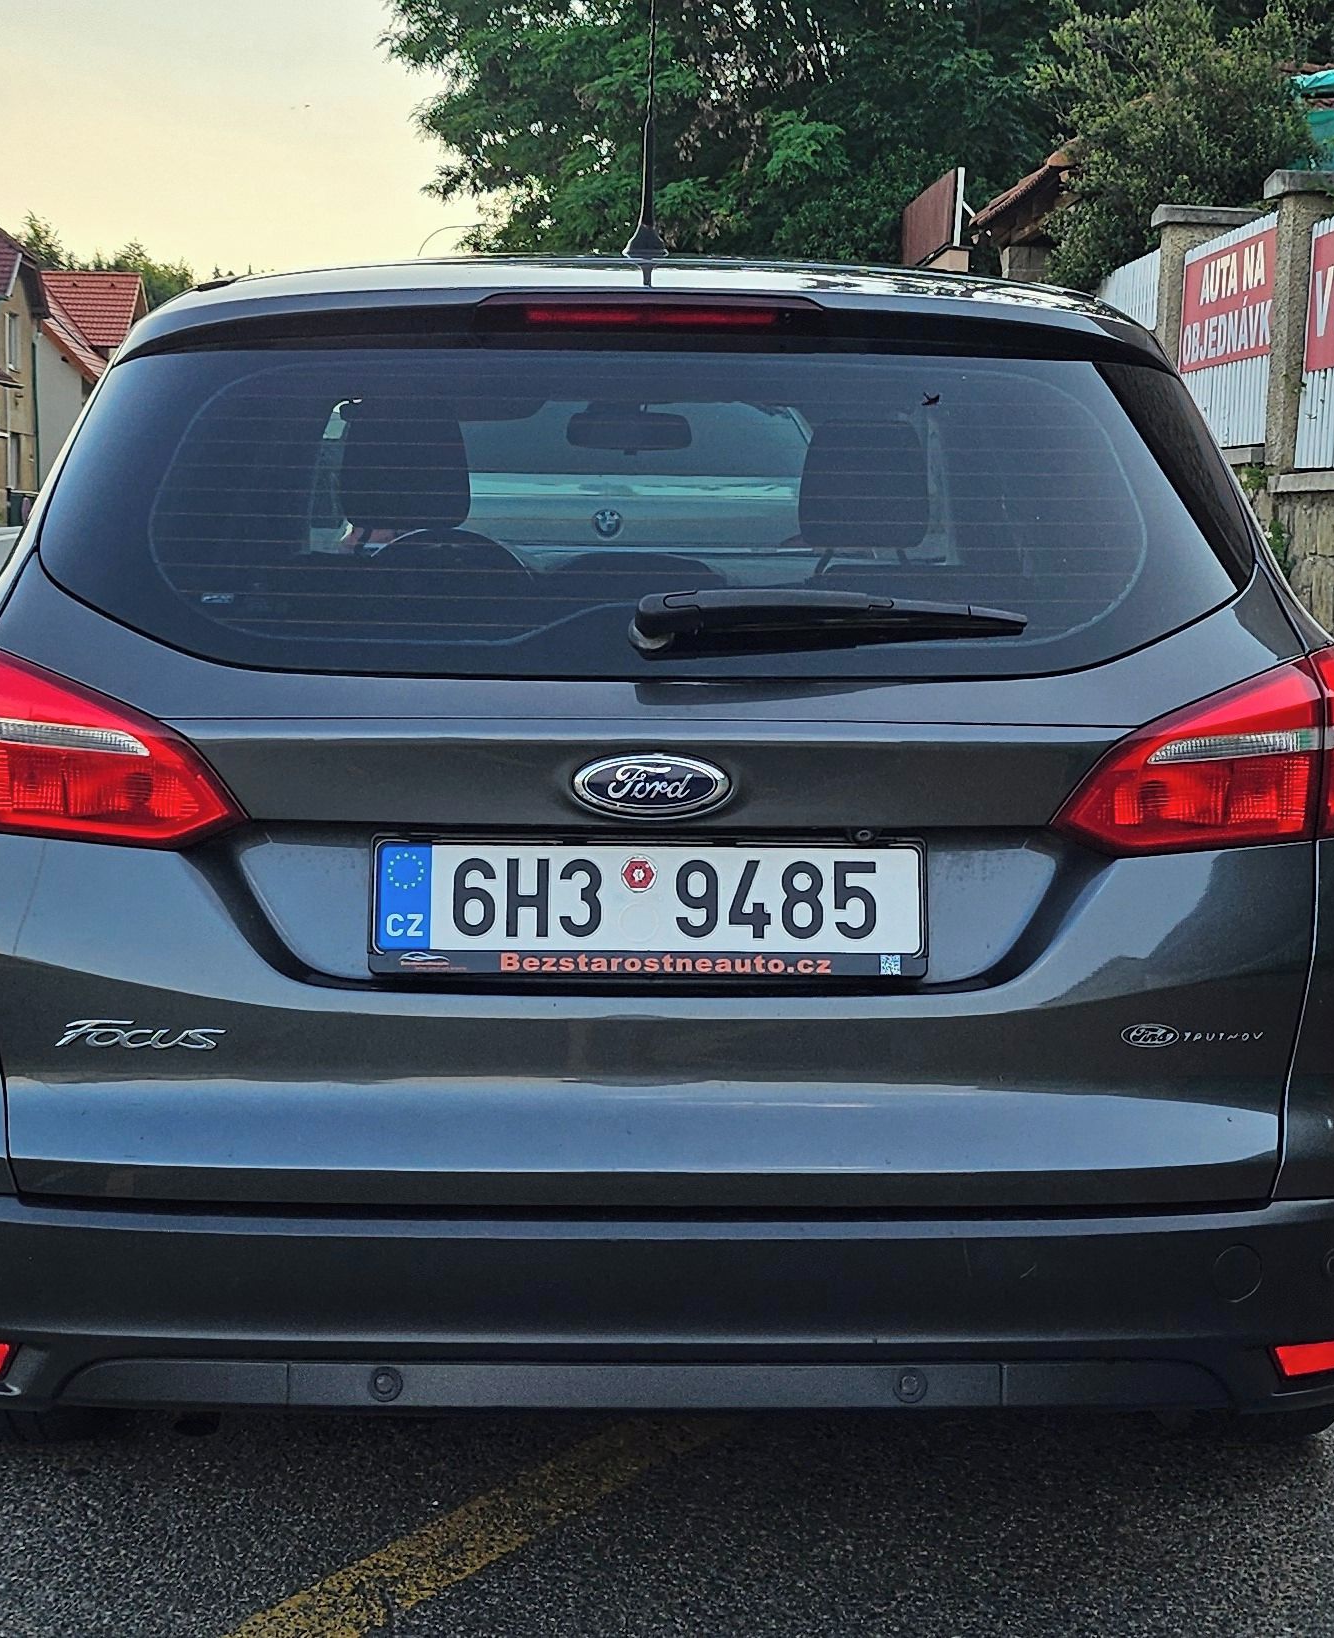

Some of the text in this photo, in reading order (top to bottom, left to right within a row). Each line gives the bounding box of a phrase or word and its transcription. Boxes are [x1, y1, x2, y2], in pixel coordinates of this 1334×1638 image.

[1199, 240, 1266, 307] AUTA NA
[1182, 295, 1273, 366] OBJEDNÁVK
[607, 764, 694, 799] Ford
[452, 857, 877, 940] 6H3 9485
[386, 913, 424, 937] CZ
[499, 951, 832, 974] Bezstarostneauto.cz
